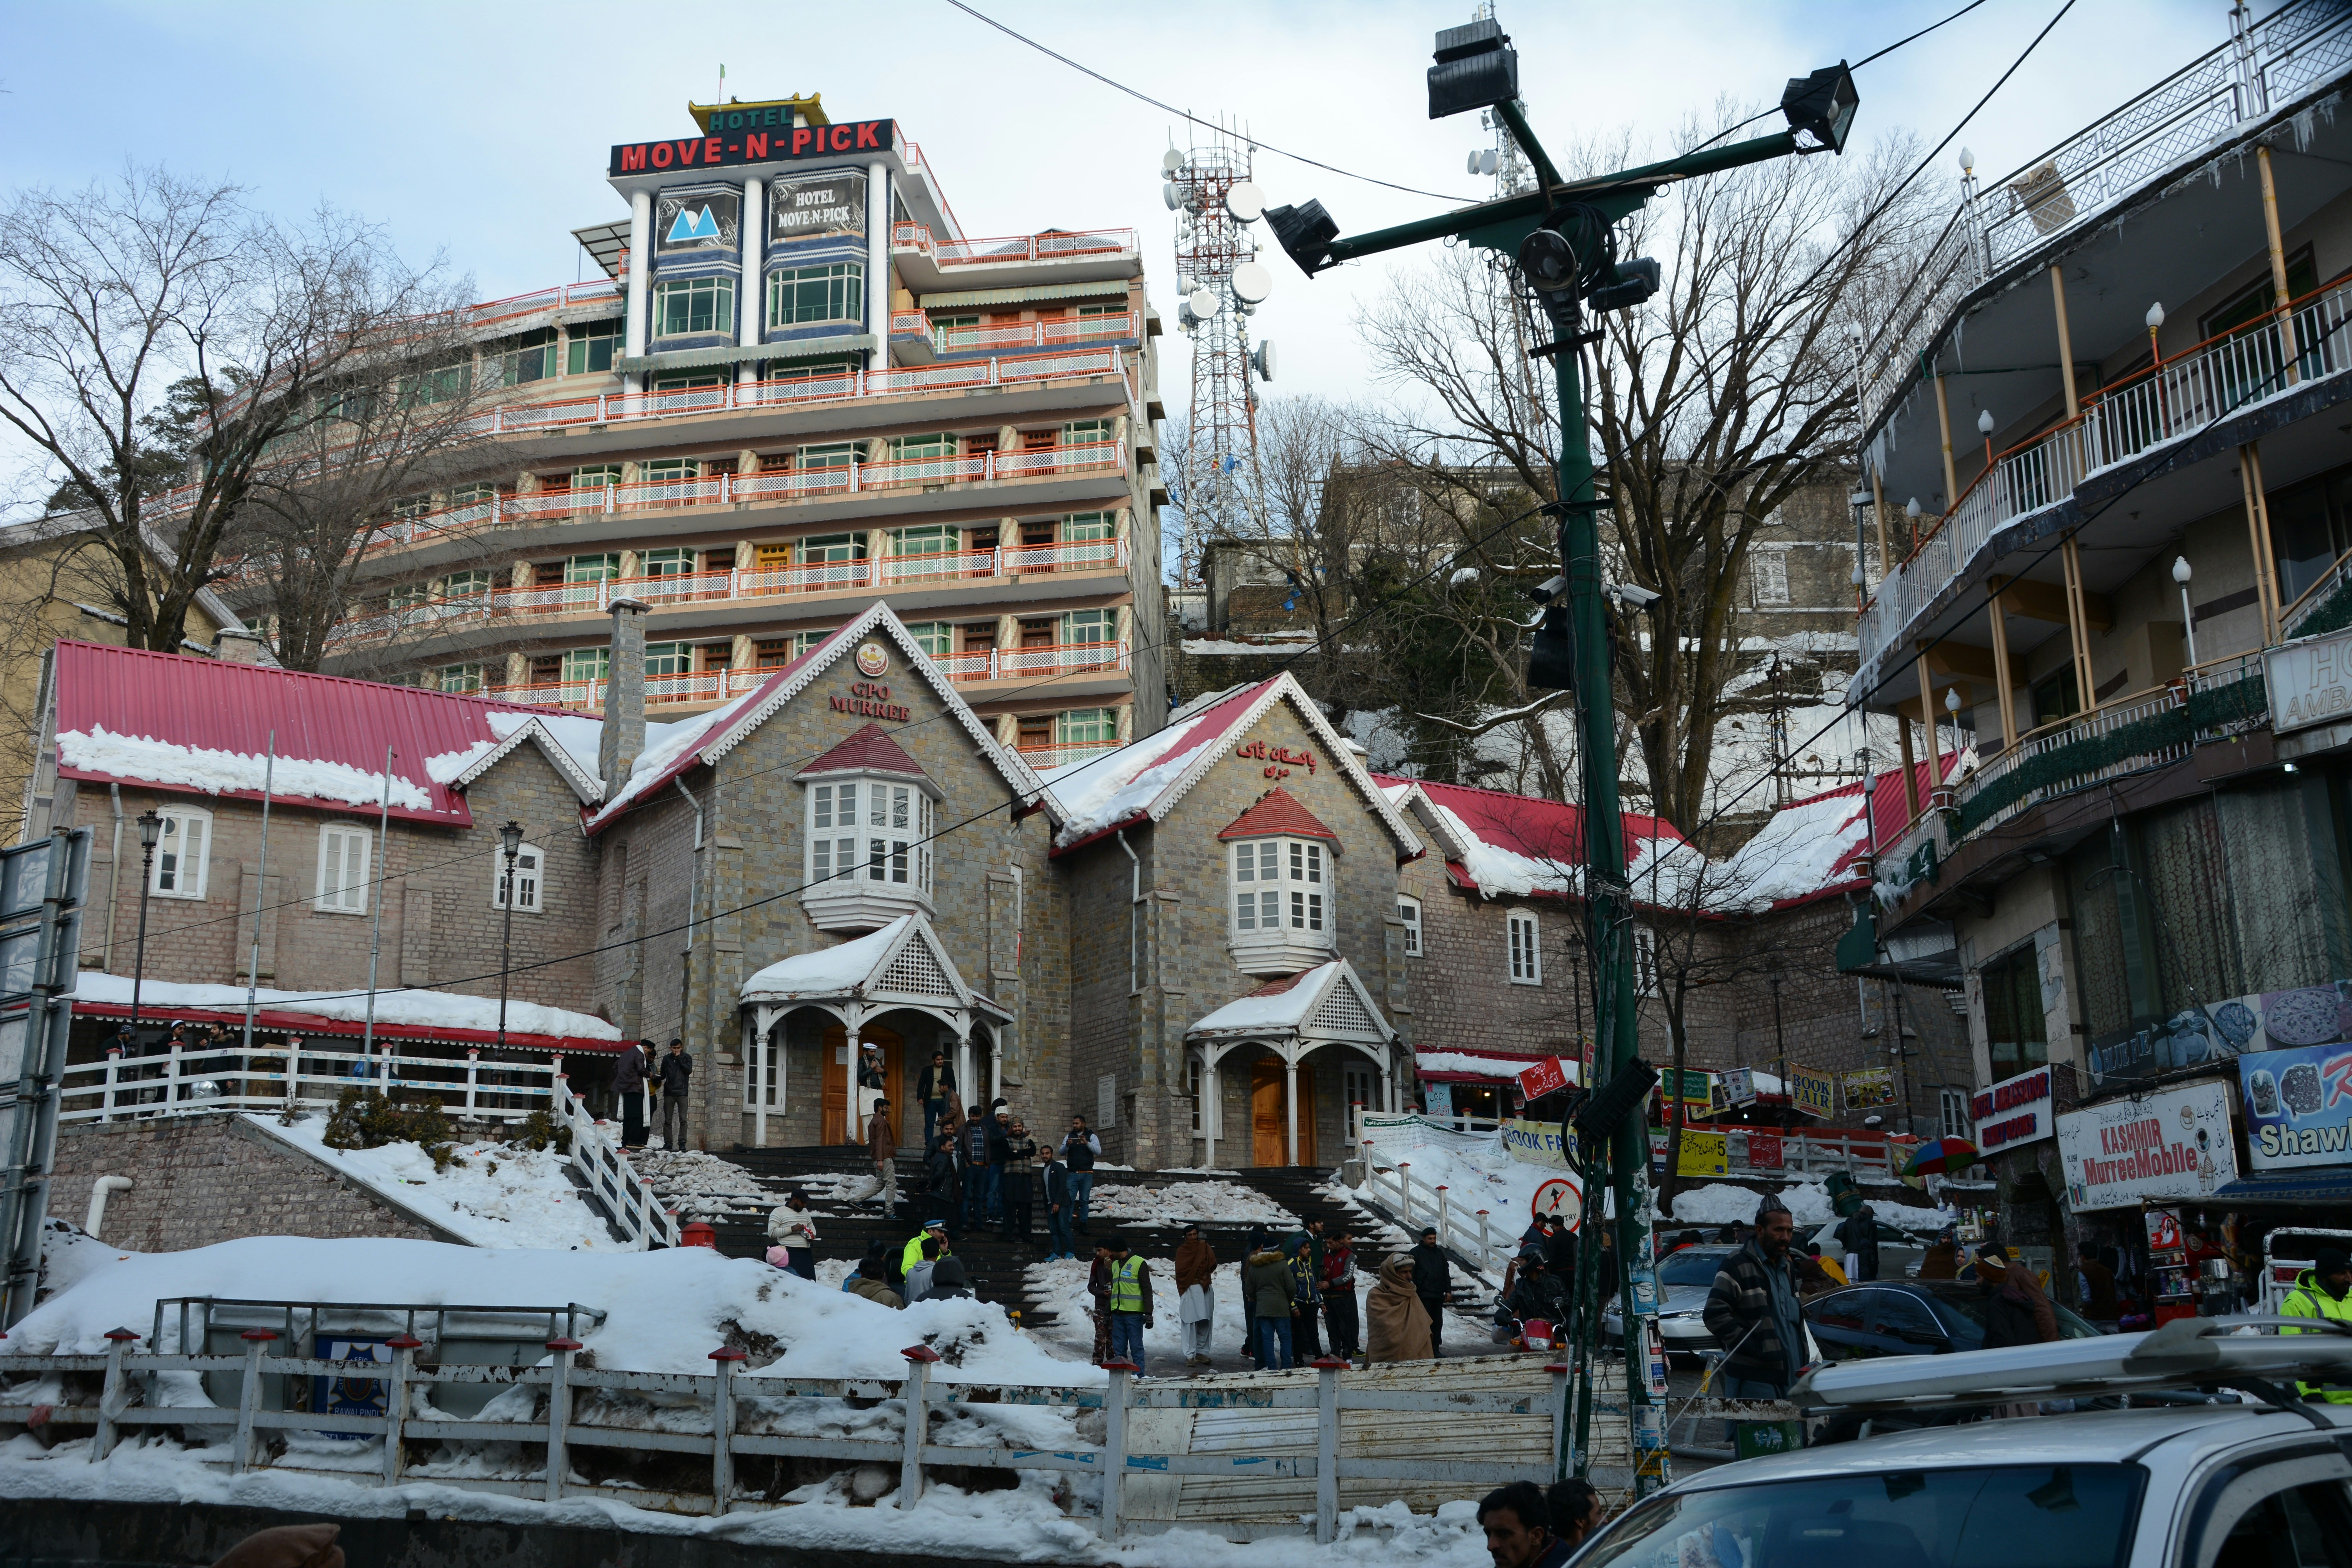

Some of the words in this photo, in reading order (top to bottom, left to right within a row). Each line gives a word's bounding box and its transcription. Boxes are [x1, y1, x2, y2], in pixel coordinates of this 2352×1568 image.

[710, 107, 794, 131] HOTEL
[621, 121, 880, 171] MOVE-N-PICK
[795, 189, 836, 207] HOTEL
[779, 206, 850, 228] MOVE-N-PICK
[852, 682, 891, 699] GPO
[830, 696, 911, 721] MURREE
[1236, 740, 1266, 760] ڈاک
[1270, 747, 1317, 775] پاکستان
[1264, 765, 1290, 780] مری
[2102, 1042, 2130, 1073] BLUE
[1793, 1074, 1830, 1095] BOOK
[1795, 1066, 1830, 1082] WELCOME
[1794, 1087, 1829, 1109] FAIR
[1972, 1092, 1995, 1120] HOTEL
[1994, 1072, 2049, 1112] AMBASSADOR
[1504, 1127, 1543, 1151] BOOK
[1545, 1134, 1579, 1153] FAR
[1982, 1122, 2006, 1147] FAMILY
[2005, 1112, 2036, 1140] ROOMS
[2100, 1118, 2164, 1155] KASHMIR
[1702, 1139, 1717, 1154] فروری
[1717, 1140, 1725, 1156] 5
[2067, 1154, 2077, 1162] SLUSH
